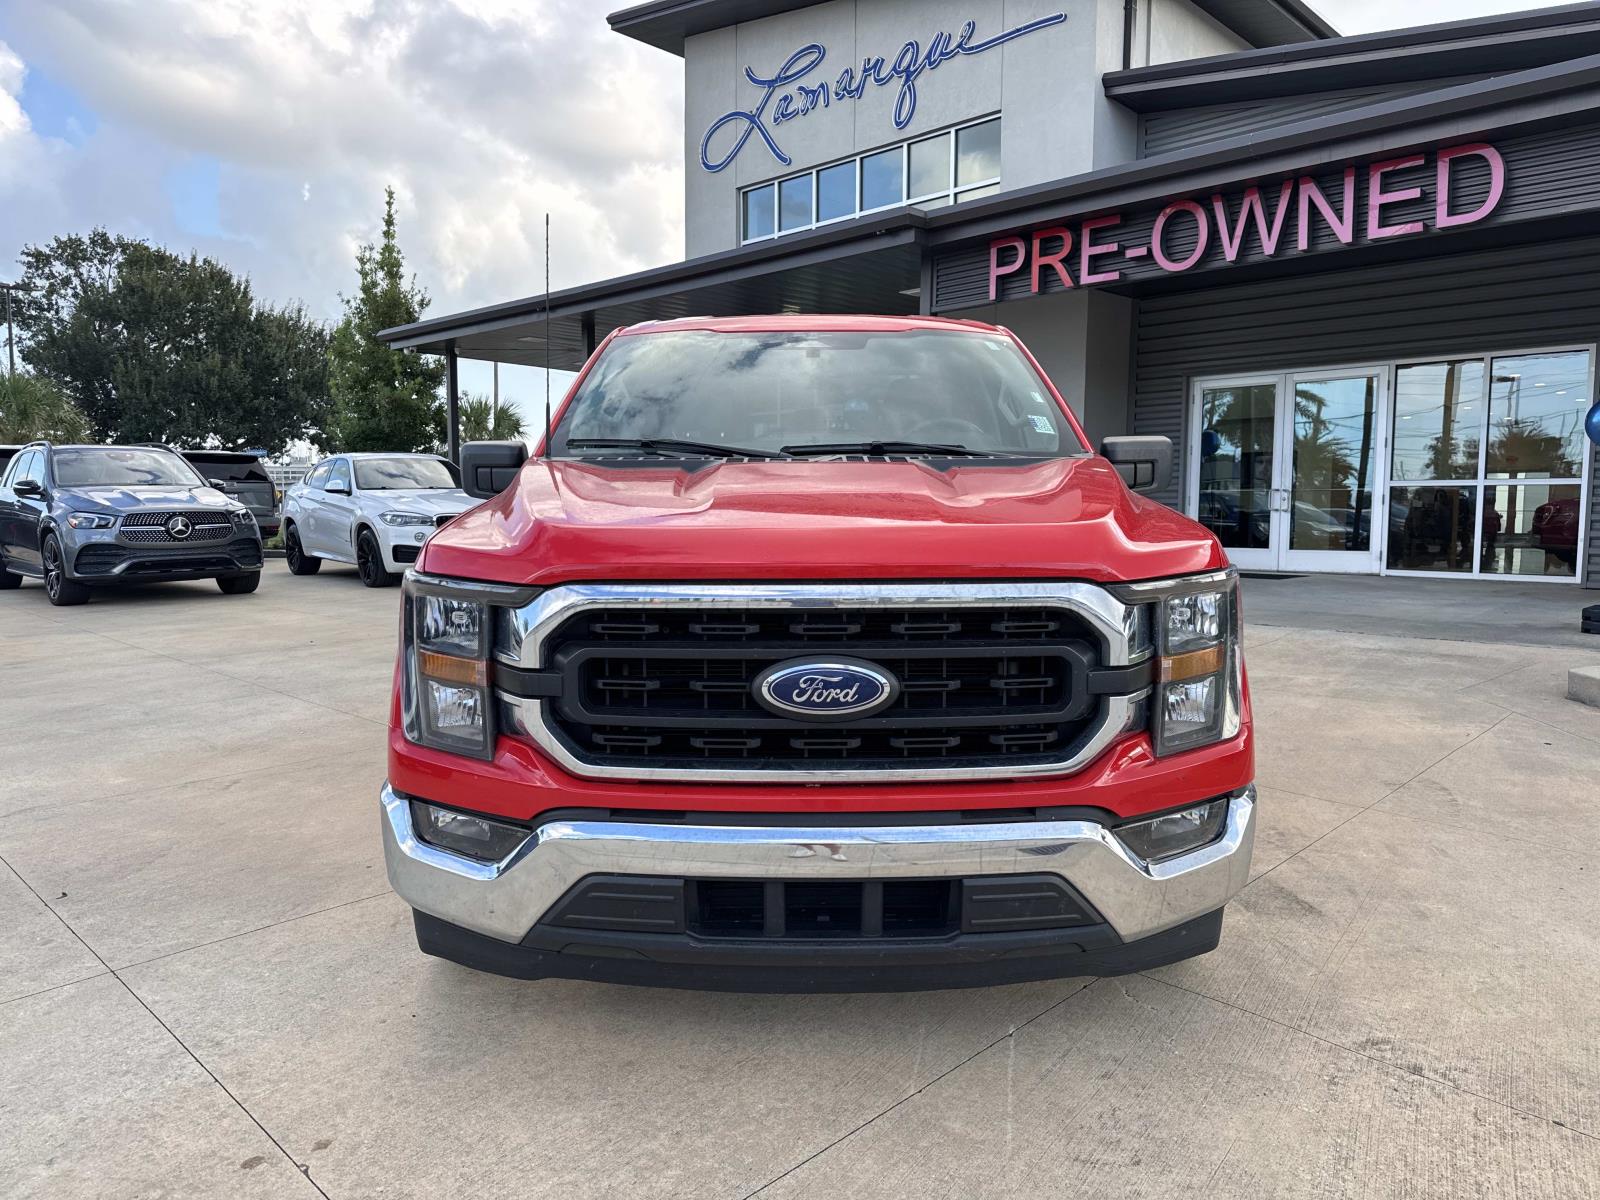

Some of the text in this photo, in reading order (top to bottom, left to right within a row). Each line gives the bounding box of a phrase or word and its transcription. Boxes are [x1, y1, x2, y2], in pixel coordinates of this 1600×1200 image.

[700, 12, 1067, 172] Lamarque
[988, 143, 1507, 301] PRE-OWNED
[793, 675, 859, 703] Ford
